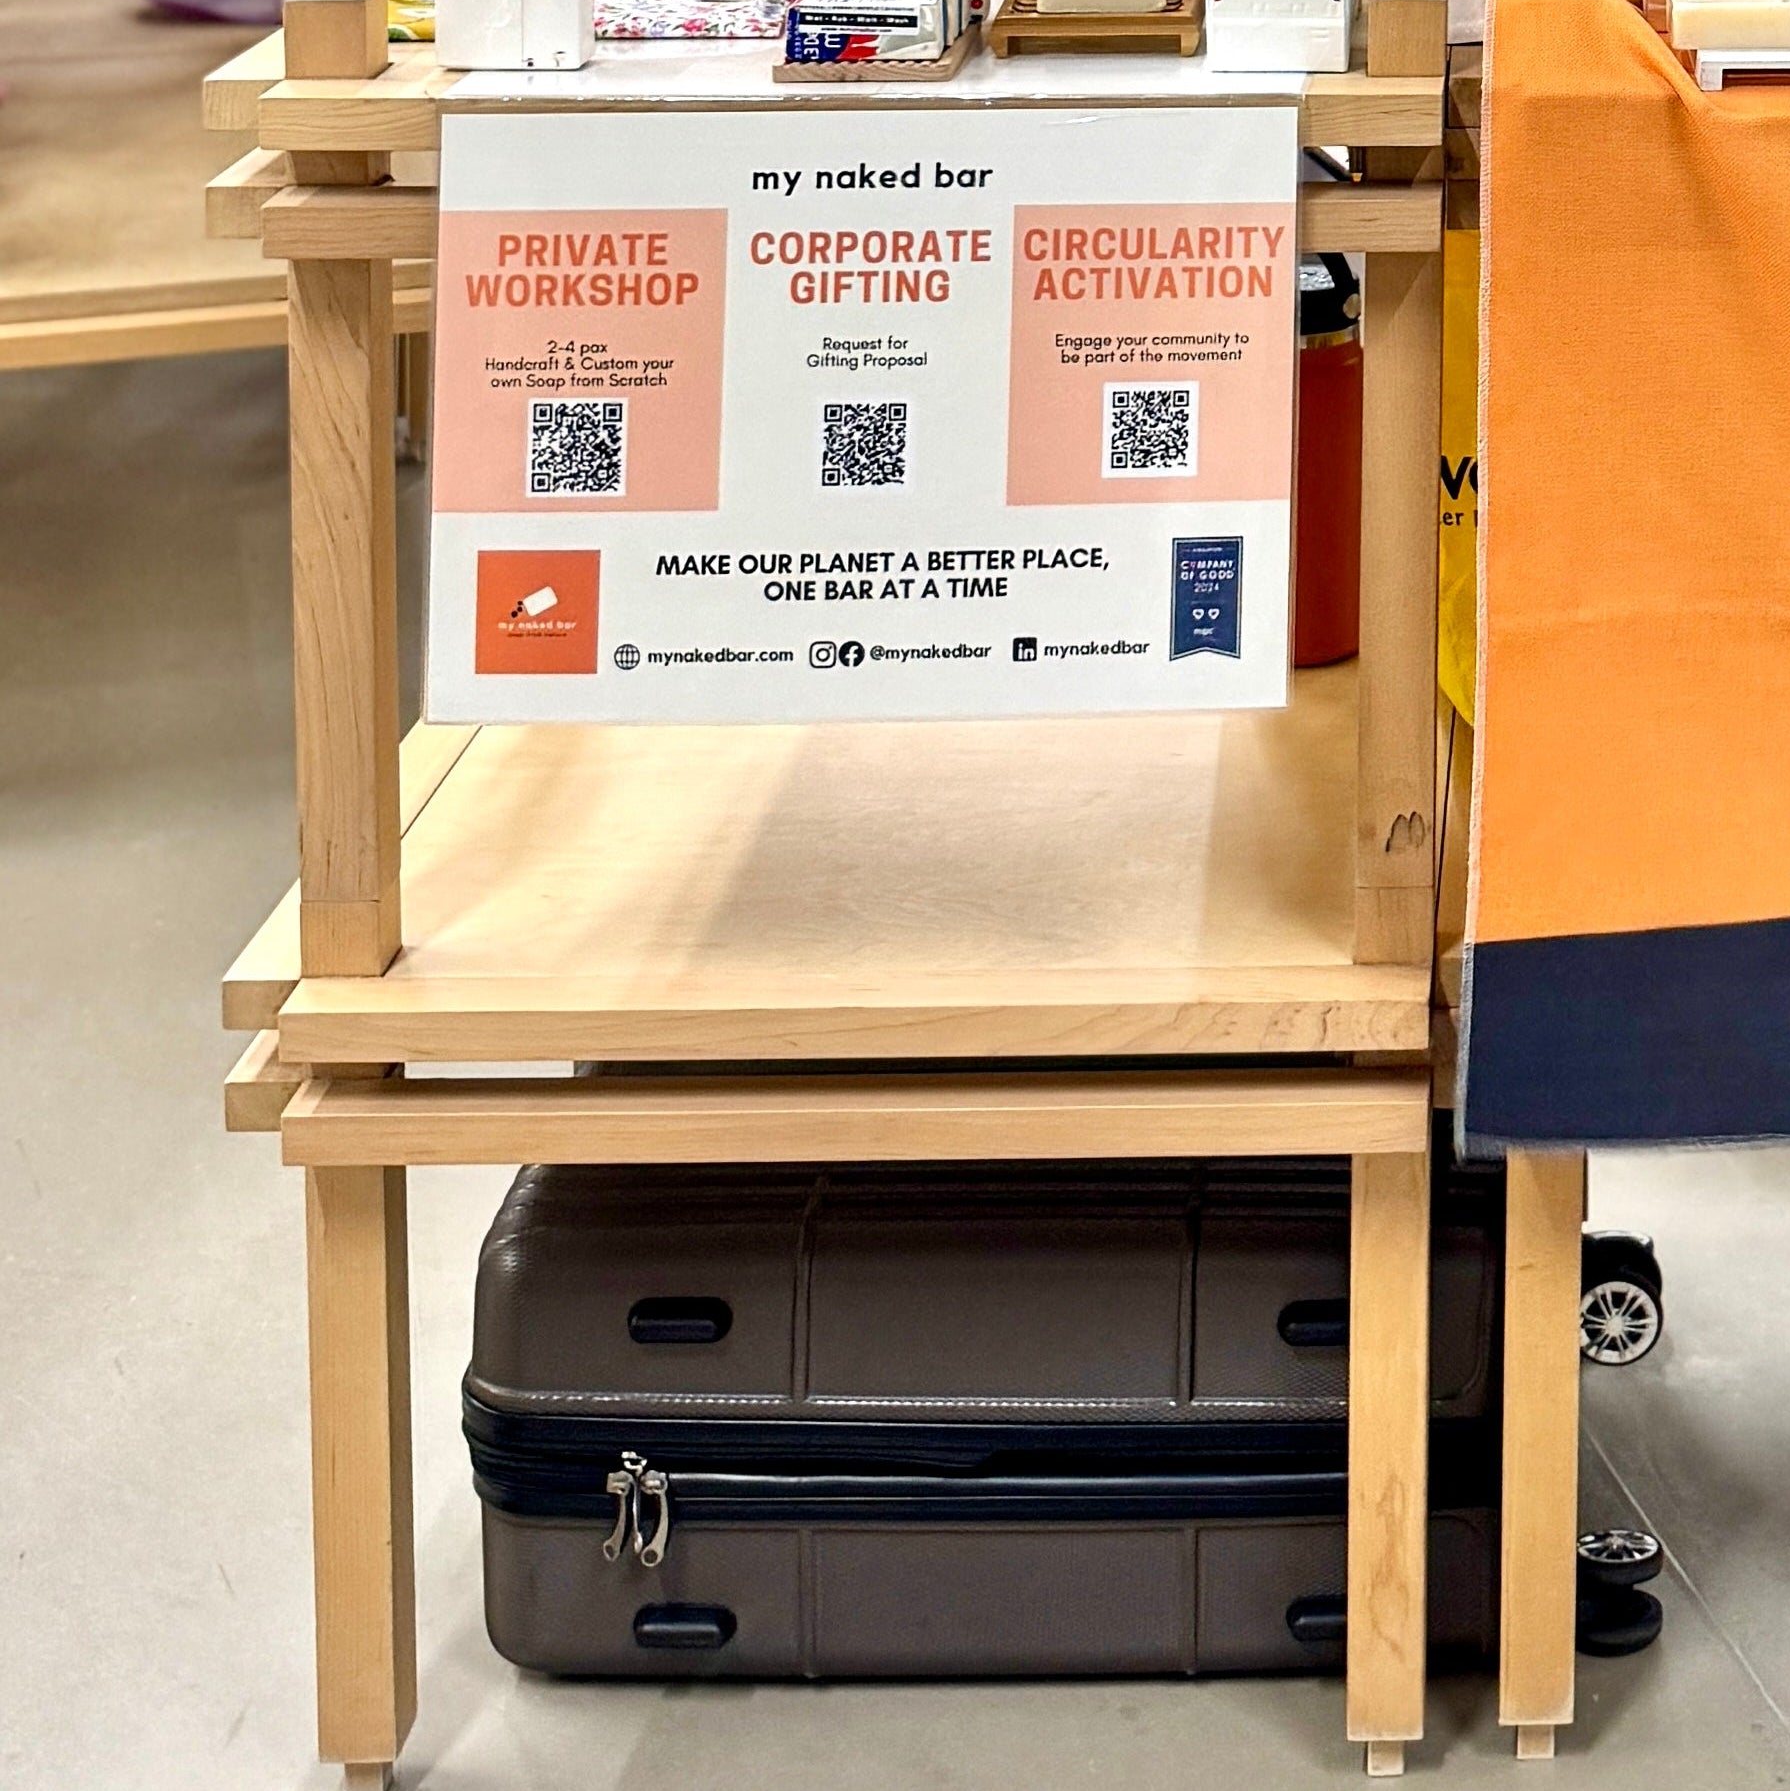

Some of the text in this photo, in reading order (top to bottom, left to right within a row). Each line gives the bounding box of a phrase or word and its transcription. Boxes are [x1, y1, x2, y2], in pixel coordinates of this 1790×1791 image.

[752, 161, 994, 197] my naked bar
[498, 233, 669, 267] PRIVATE
[750, 229, 992, 265] CORPORATE
[1023, 226, 1285, 262] CIRCULARITY
[465, 272, 699, 307] WORKSHOP
[790, 269, 950, 304] GIFTING
[1033, 265, 1272, 301] ACTIVATION
[547, 340, 608, 357] 2-4 pax
[822, 335, 908, 354] Request for
[1055, 333, 1250, 352] Engage your community to
[485, 356, 674, 373] Handcraft & Custom your
[806, 351, 928, 371] Gifting Proposal
[1061, 348, 1242, 367] be part of the movement
[490, 371, 668, 392] own Soap from Scratch
[655, 547, 1109, 576] MAKE OUR PLANET A BETTER PLACE,
[763, 577, 1008, 602] ONE BAR AT A TIME
[647, 647, 794, 667] mynakedbar.com
[869, 643, 992, 663] @mynakedbar
[1044, 640, 1150, 659] mynakedbar
